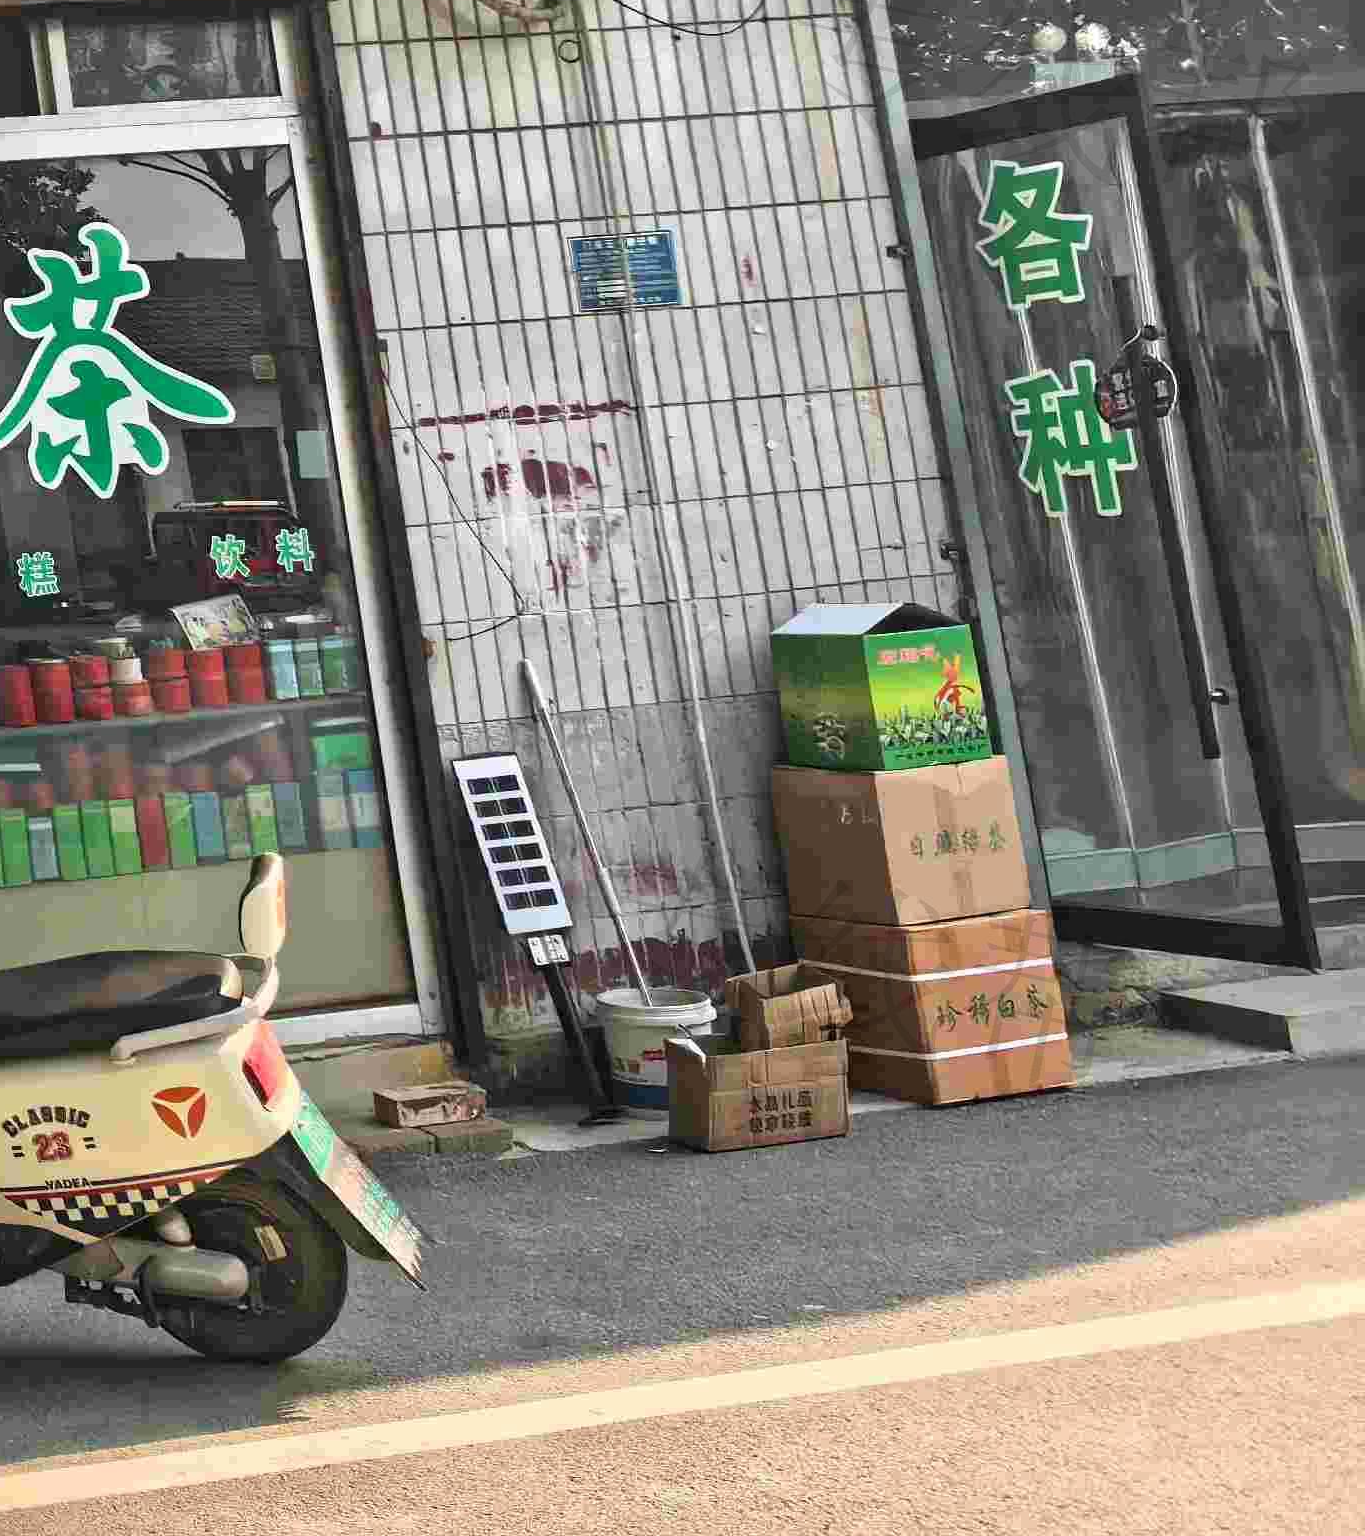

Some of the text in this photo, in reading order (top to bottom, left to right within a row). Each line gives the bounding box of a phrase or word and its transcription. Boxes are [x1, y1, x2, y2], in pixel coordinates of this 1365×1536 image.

[975, 158, 1139, 518] 各种
[210, 528, 315, 578] 饮料
[44, 1177, 91, 1190] YADEA
